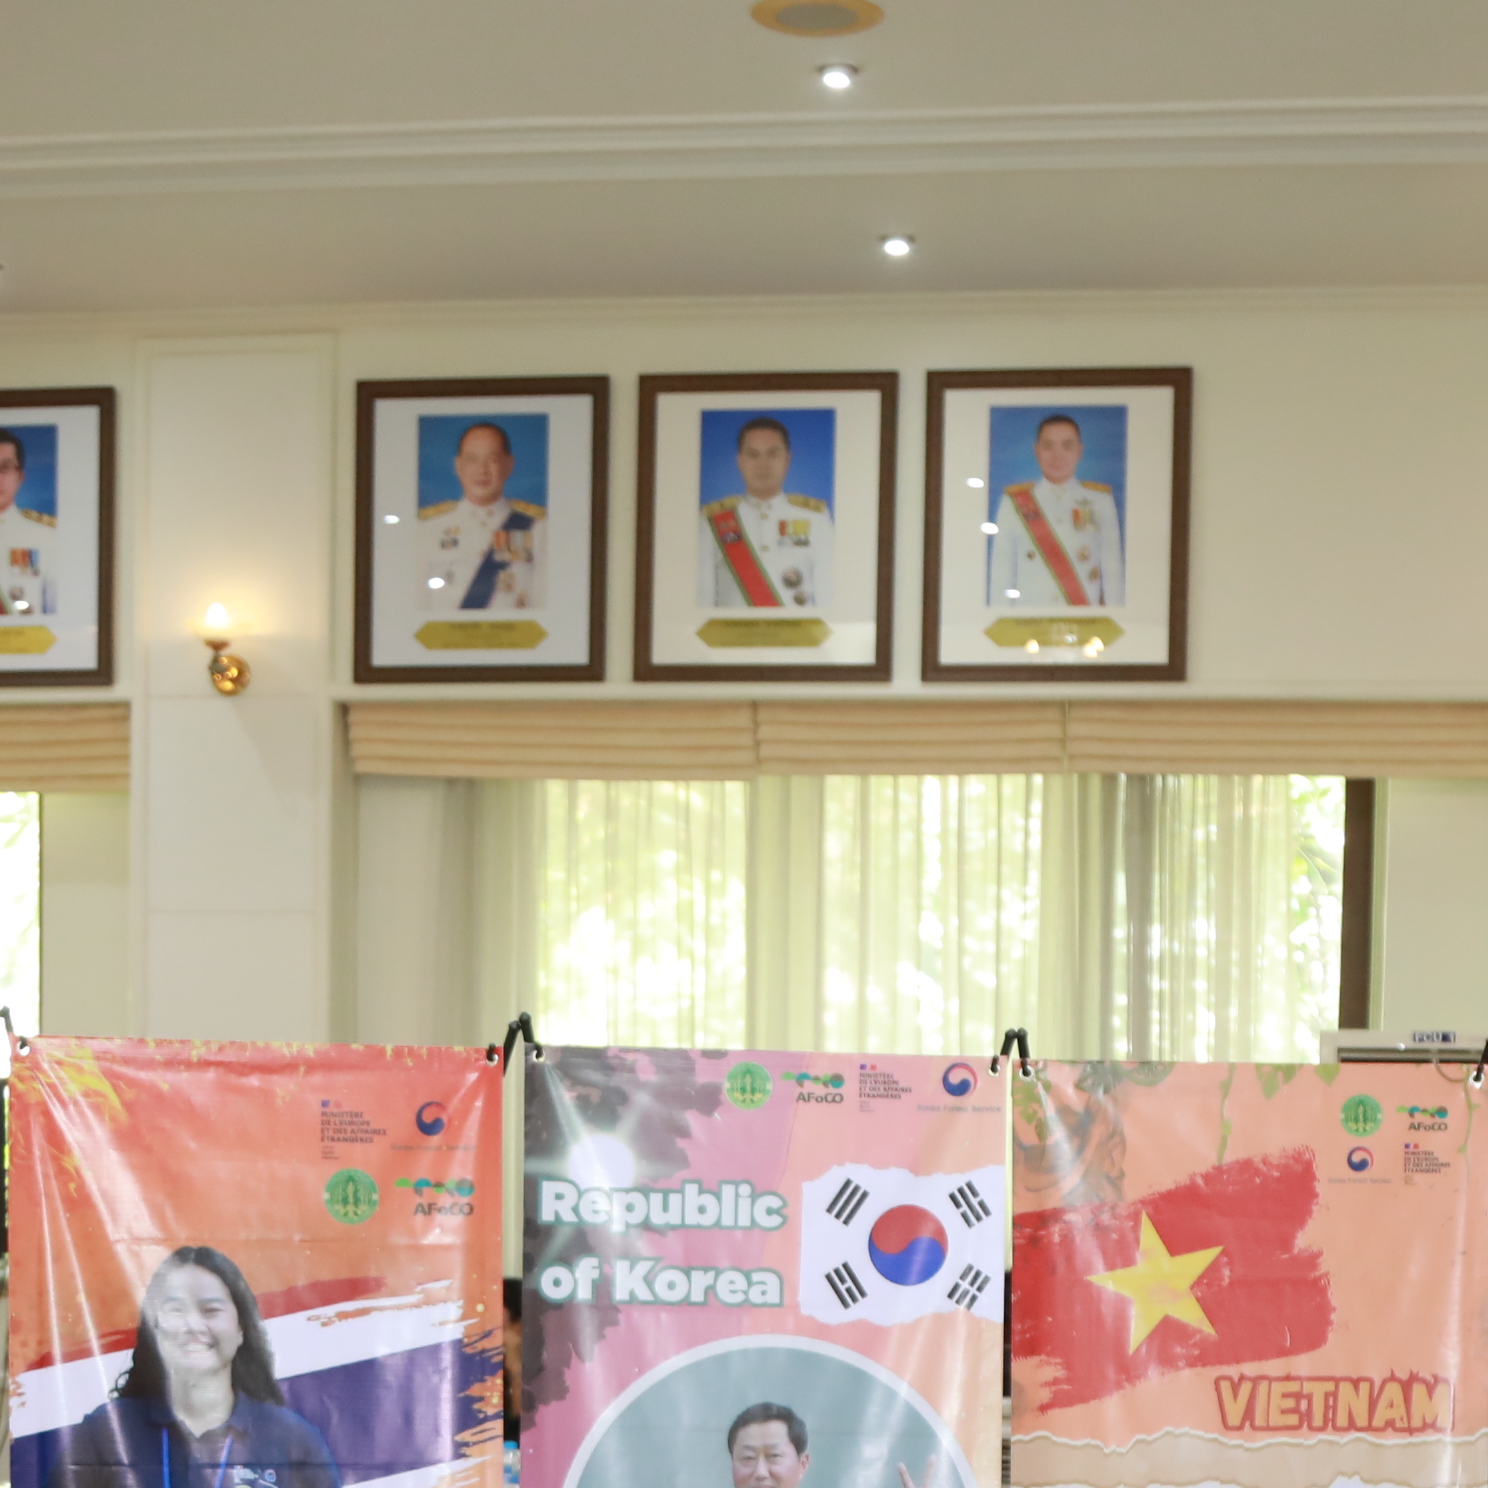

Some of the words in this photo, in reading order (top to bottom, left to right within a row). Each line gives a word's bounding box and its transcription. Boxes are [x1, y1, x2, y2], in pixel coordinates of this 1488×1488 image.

[796, 1091, 845, 1104] AFoCO
[1408, 1121, 1448, 1132] AFoCO
[538, 1178, 788, 1232] Republic
[539, 1257, 600, 1305] of
[611, 1256, 785, 1306] Korea
[1215, 1375, 1454, 1433] VIETNAM
